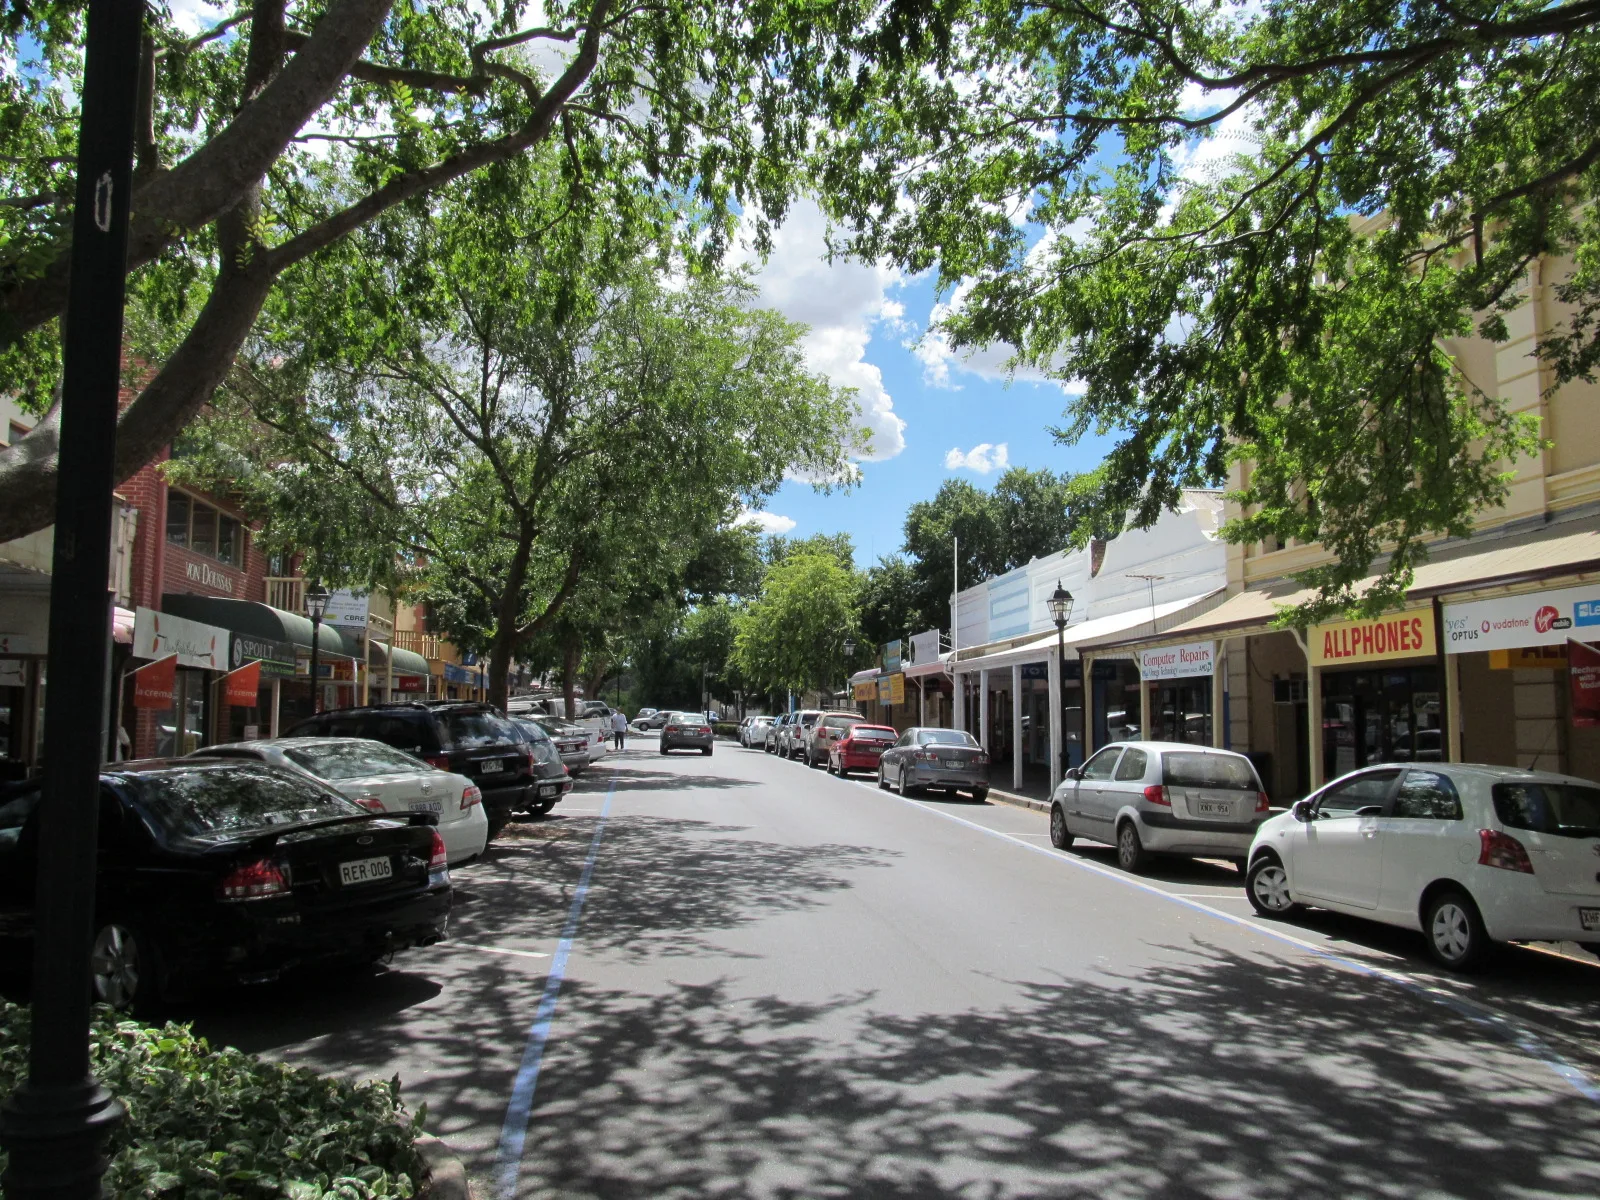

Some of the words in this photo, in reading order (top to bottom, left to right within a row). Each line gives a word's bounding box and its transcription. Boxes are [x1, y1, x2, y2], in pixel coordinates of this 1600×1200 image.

[344, 614, 366, 622] CBRE
[1492, 617, 1529, 630] vodafone
[1552, 619, 1570, 628] mobile
[1323, 617, 1423, 659] ALLPHONES
[1451, 629, 1479, 641] OPTUS
[243, 640, 273, 659] SPOILT
[1143, 652, 1176, 668] Computer
[1180, 648, 1210, 664] Repairs
[135, 683, 144, 696] la
[144, 687, 173, 698] crema
